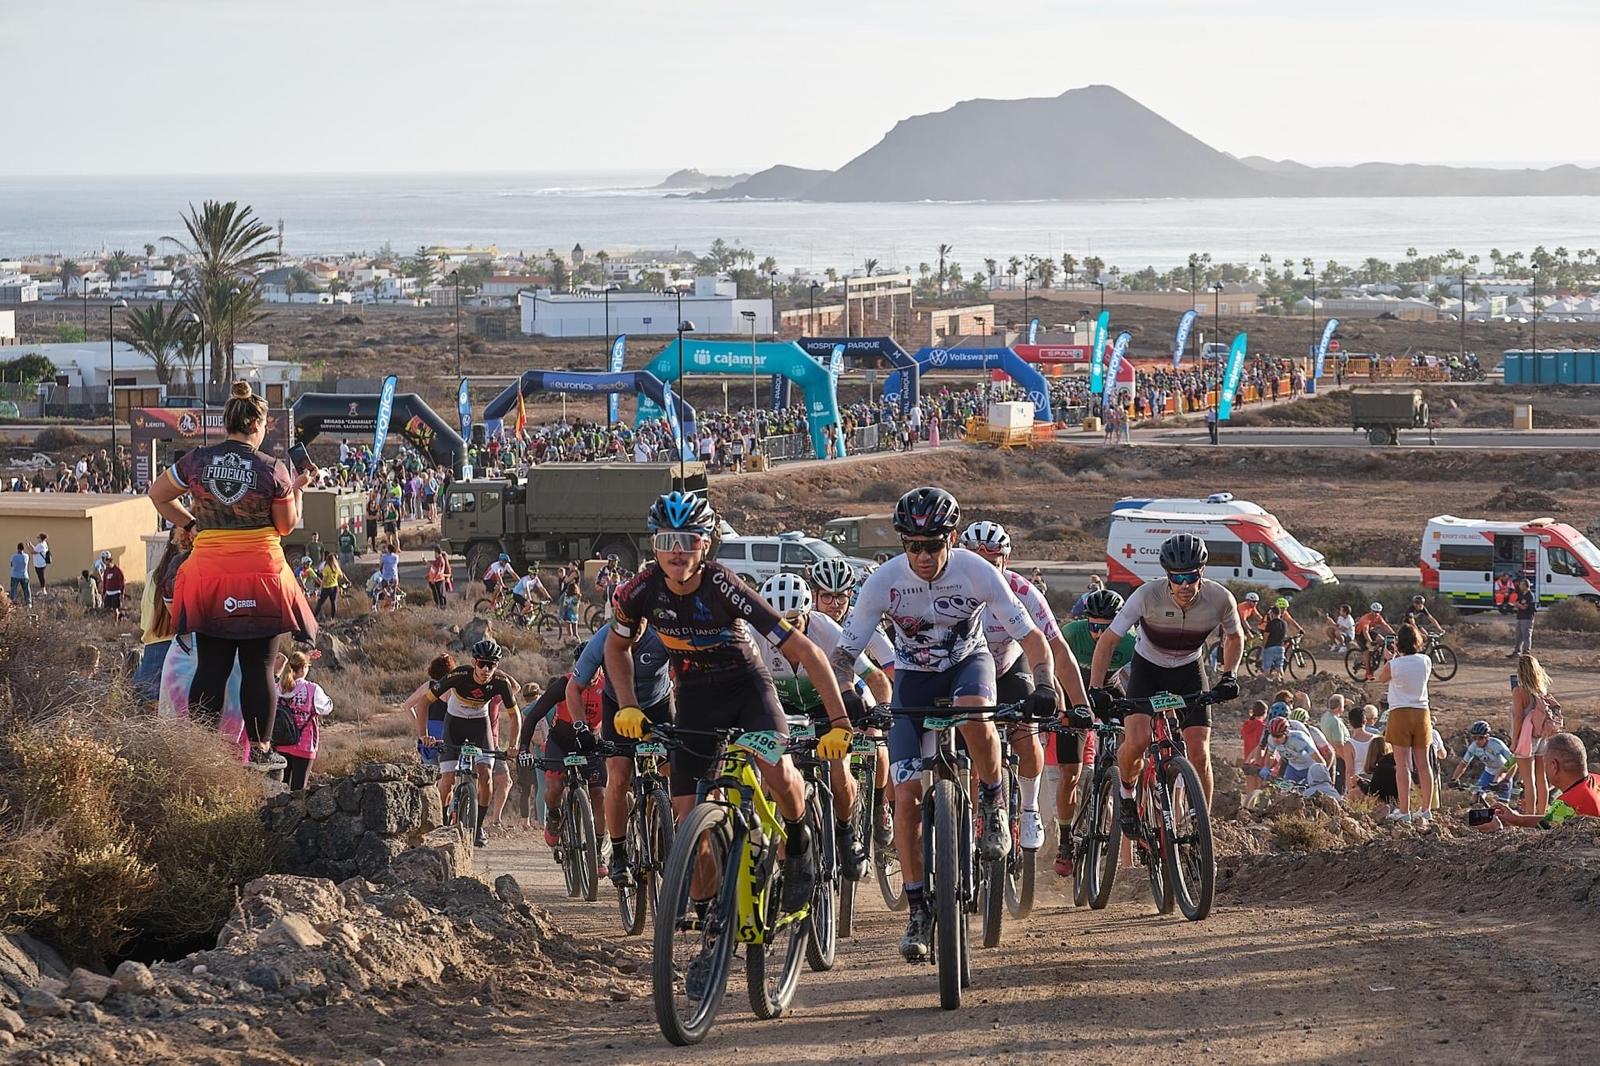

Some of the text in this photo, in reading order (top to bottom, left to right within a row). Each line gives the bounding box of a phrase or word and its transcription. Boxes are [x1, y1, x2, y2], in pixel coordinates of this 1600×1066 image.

[847, 341, 881, 350] PARQUE
[713, 352, 767, 367] cajamar
[949, 352, 999, 362] Volkswagen
[554, 381, 595, 391] euronics
[206, 465, 253, 483] FUDENAS
[1139, 547, 1160, 555] Cruz
[712, 570, 753, 616] Cofete
[237, 599, 257, 608] GROSA
[1153, 697, 1178, 705] 2744
[745, 733, 777, 751] 2196
[748, 742, 768, 755] FABIO
